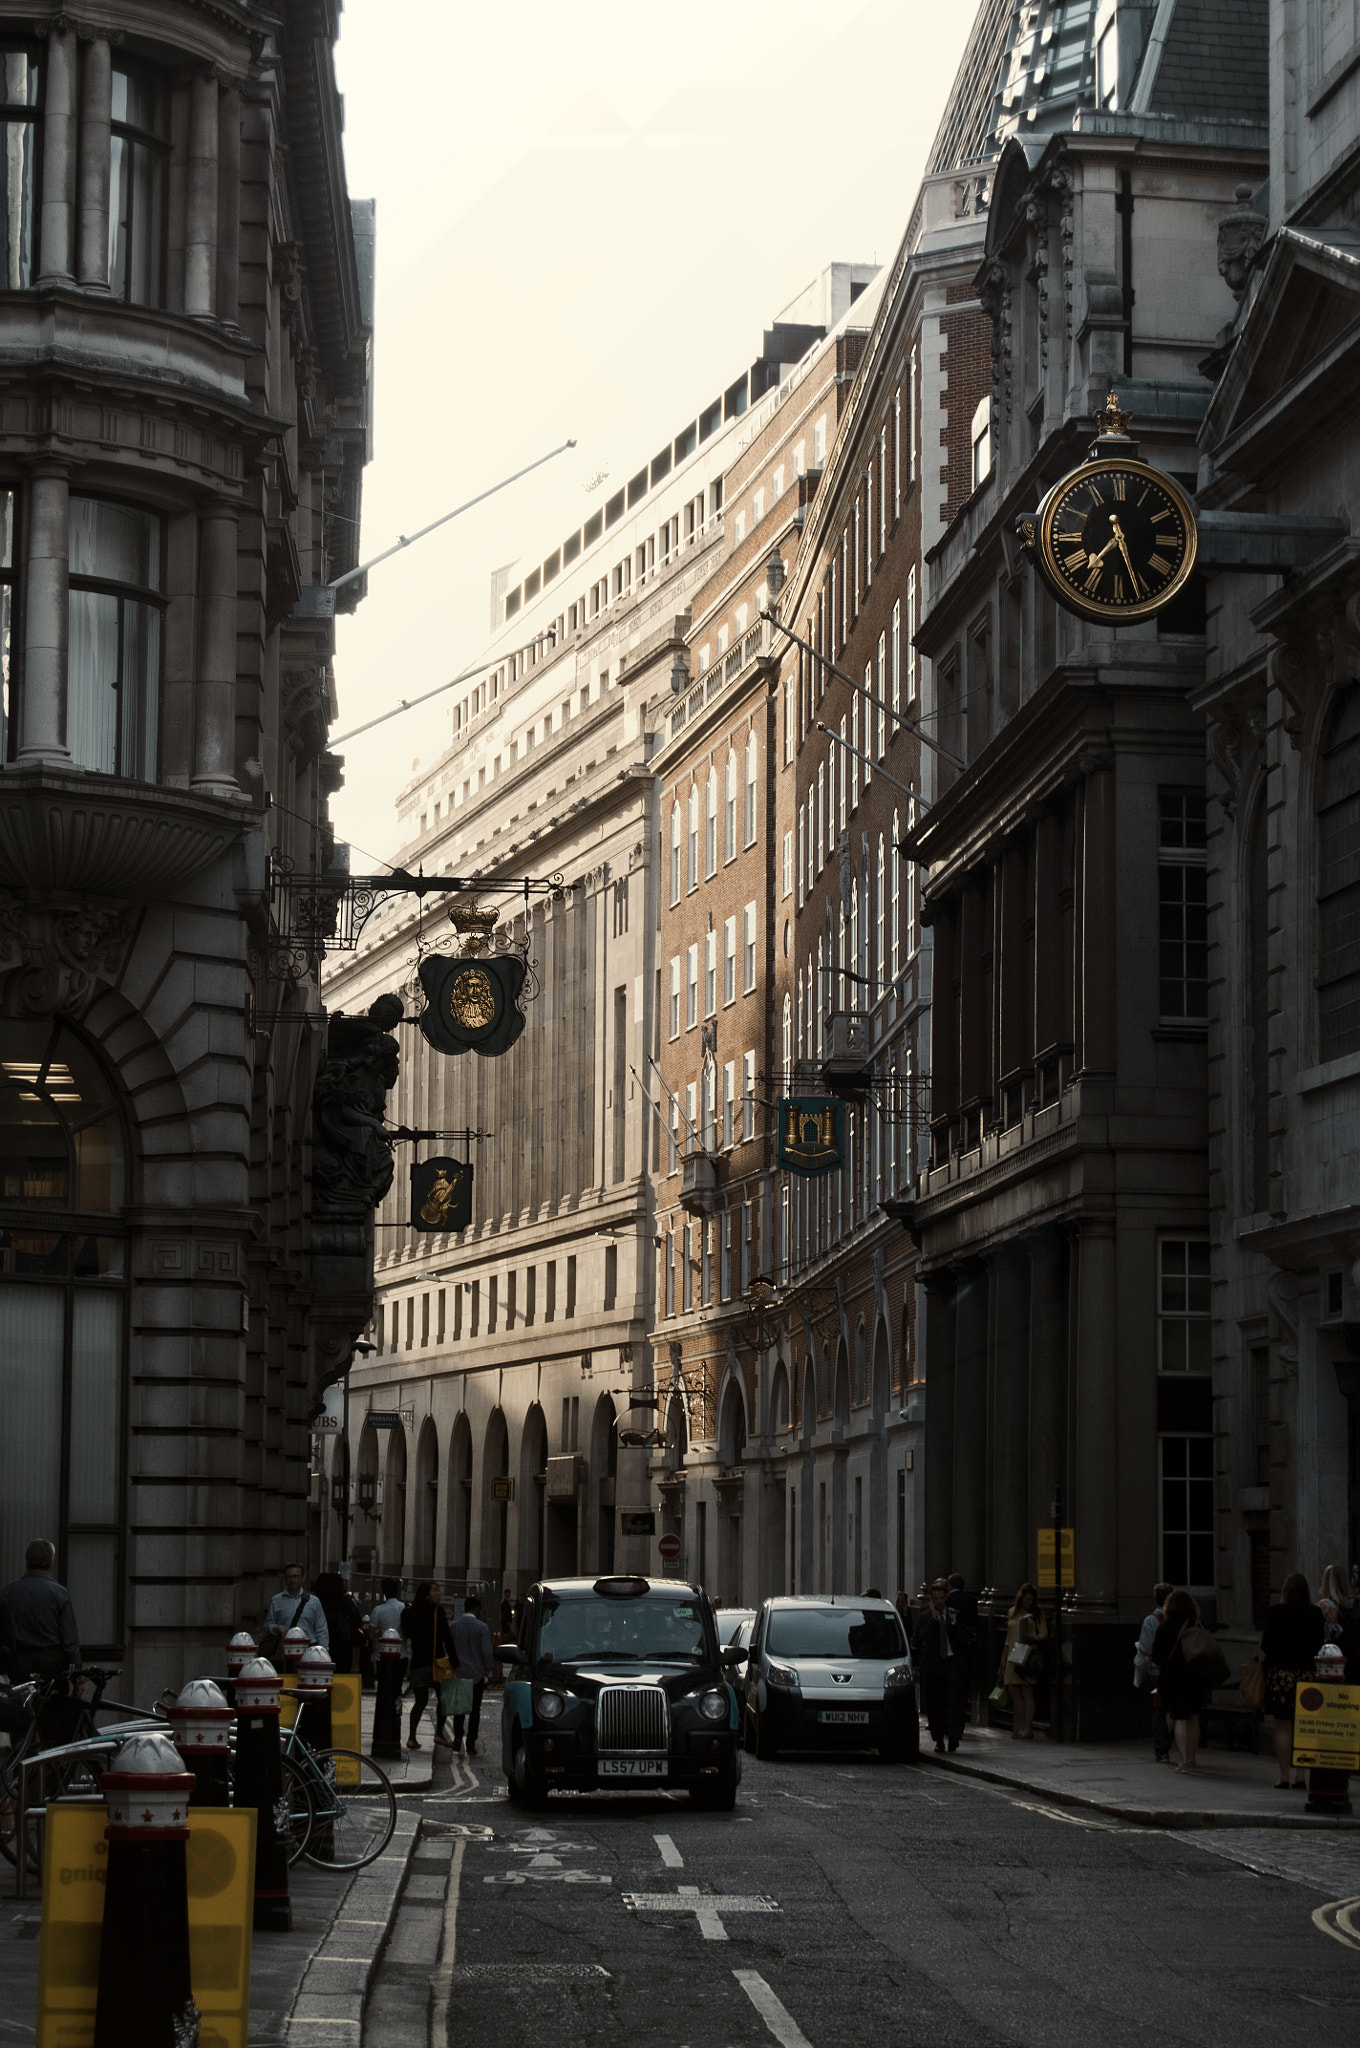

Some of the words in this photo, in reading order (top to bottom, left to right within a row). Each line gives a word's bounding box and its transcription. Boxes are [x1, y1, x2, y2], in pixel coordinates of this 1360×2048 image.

[1327, 1702, 1360, 1711] stopping
[603, 1761, 635, 1773] LS57
[639, 1761, 663, 1773] UPW
